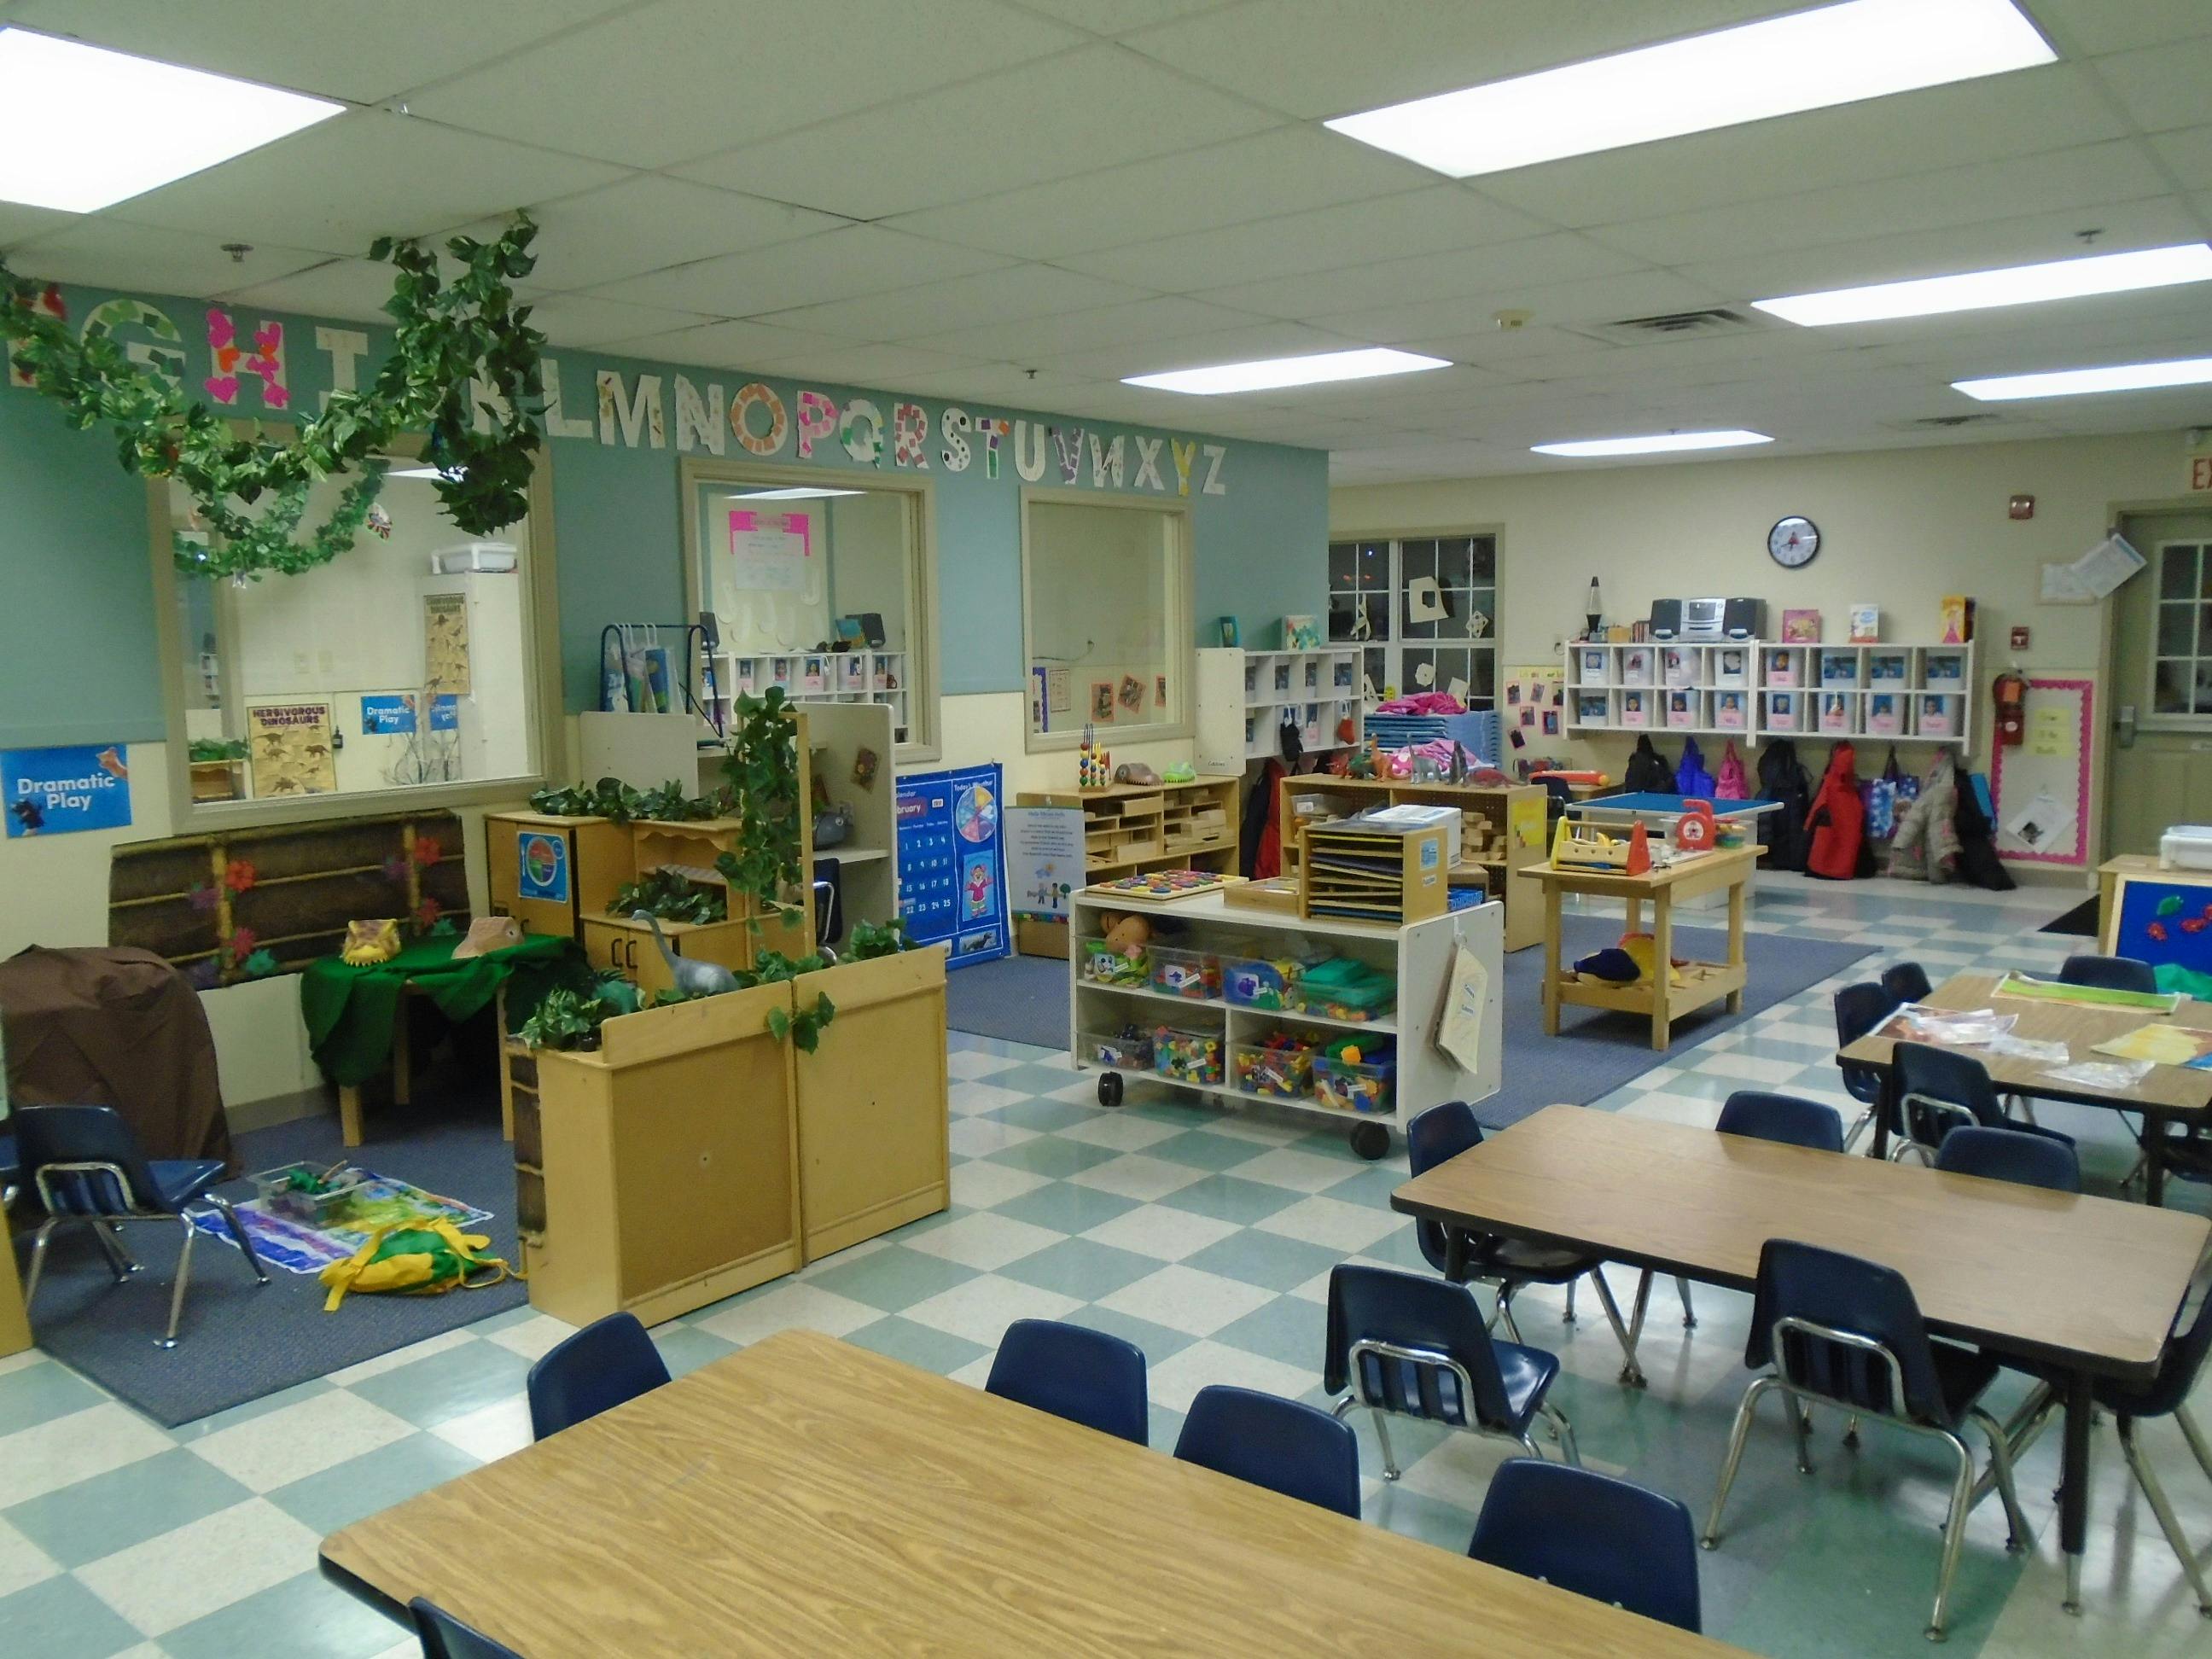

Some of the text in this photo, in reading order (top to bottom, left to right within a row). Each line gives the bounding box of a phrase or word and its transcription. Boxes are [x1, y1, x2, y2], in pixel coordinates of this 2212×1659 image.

[596, 370, 666, 449] M
[674, 373, 725, 456] N
[731, 383, 788, 456] O
[797, 390, 838, 458] P
[840, 399, 884, 469] Q
[894, 403, 930, 469] R
[941, 408, 971, 472] S
[975, 416, 1010, 480] T
[1015, 420, 1045, 481] U
[1134, 435, 1165, 491] X
[1171, 437, 1196, 497] Y
[1202, 444, 1226, 495] Z
[253, 707, 326, 718] HERBIVOROUS
[366, 706, 410, 715] Dramatic
[260, 715, 320, 726] DINOSAURS
[379, 715, 399, 725] Play
[17, 772, 115, 795] Dramatic
[46, 793, 91, 812] Play
[897, 804, 922, 815] bruary
[905, 842, 908, 851] 1
[928, 837, 934, 846] 3
[940, 835, 946, 844] 4
[906, 884, 913, 893] 15
[931, 880, 937, 888] 17
[943, 878, 949, 887] 18
[906, 899, 951, 914] 22 23 24 25
